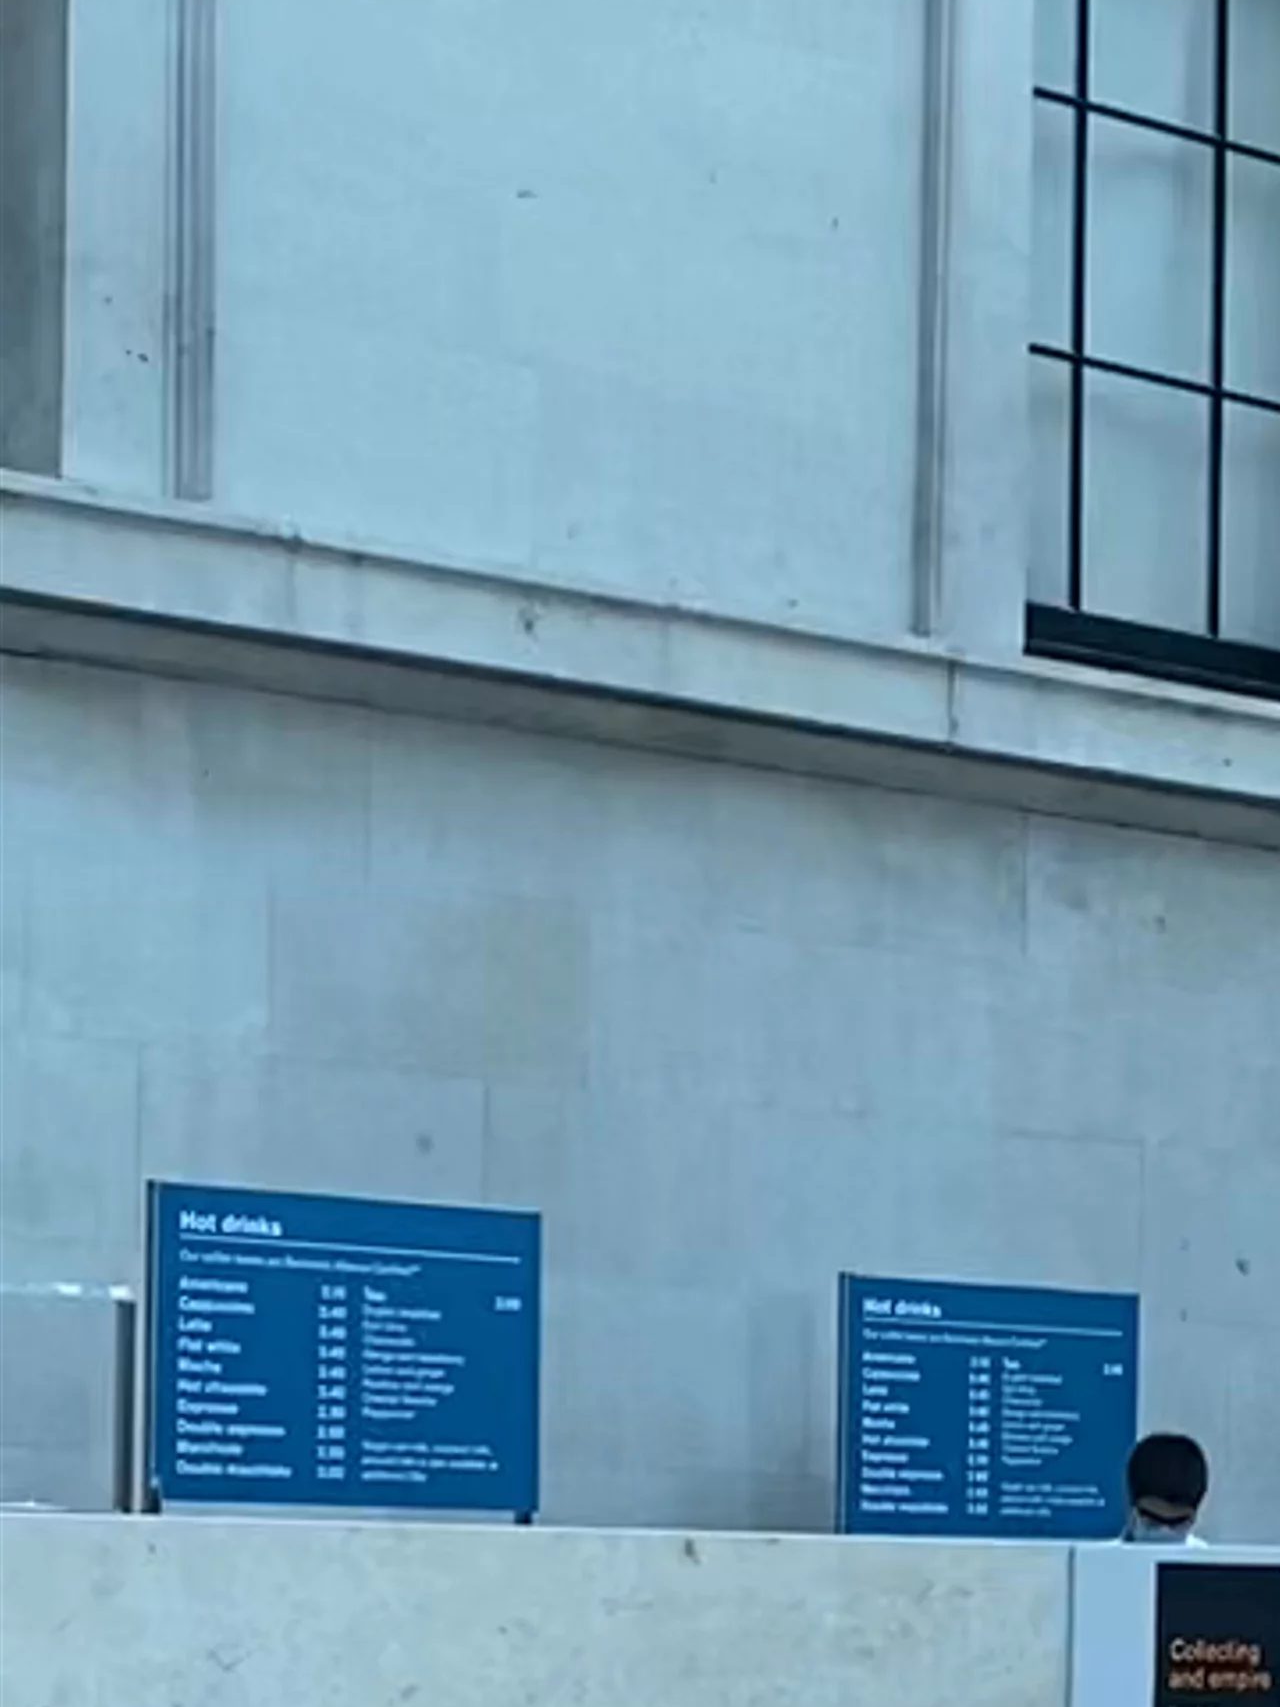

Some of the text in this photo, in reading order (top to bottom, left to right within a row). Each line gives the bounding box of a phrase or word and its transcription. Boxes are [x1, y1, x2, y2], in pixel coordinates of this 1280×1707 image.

[179, 1210, 283, 1237] Hot drinks
[862, 1297, 942, 1318] Hot drinks
[1169, 1638, 1261, 1667] Collecting
[1168, 1667, 1272, 1693] and empire
